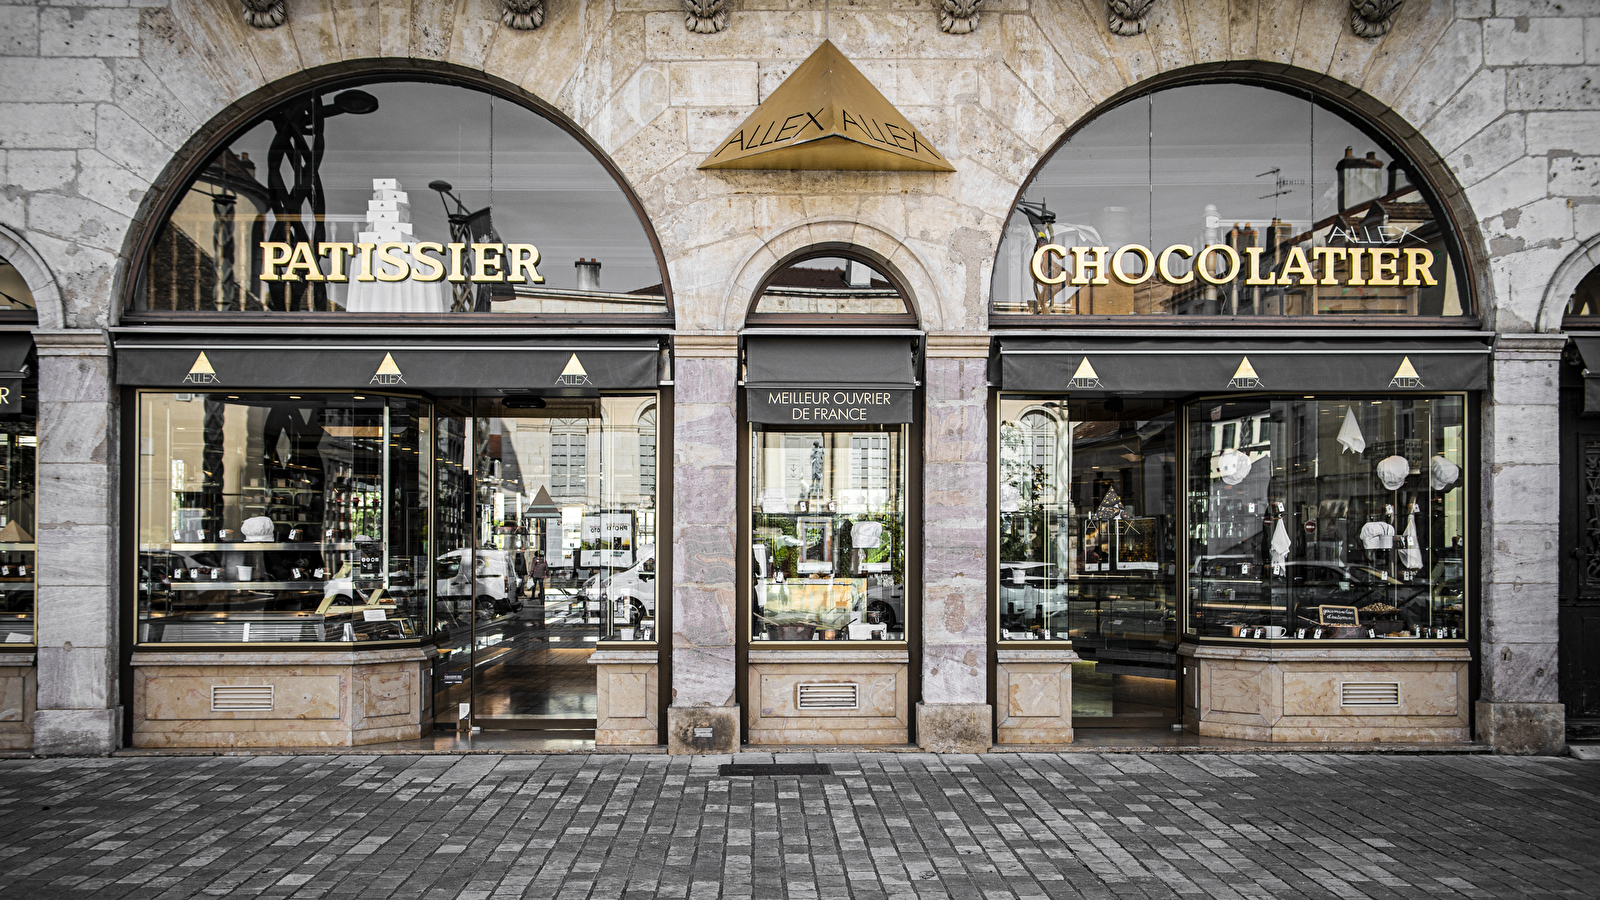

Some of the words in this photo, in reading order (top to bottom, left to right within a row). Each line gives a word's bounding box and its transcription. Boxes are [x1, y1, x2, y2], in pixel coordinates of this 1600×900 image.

[714, 107, 824, 158] ALLEX
[842, 109, 941, 160] ALLEX
[1327, 225, 1428, 244] ALLEX
[259, 241, 545, 284] PATISSIER
[1030, 243, 1438, 287] CHOCOLATIER
[182, 373, 221, 384] ALLEX
[369, 374, 407, 385] ALLEX
[554, 375, 593, 386] ALLEX
[1066, 378, 1105, 389] ALLEX
[1226, 378, 1265, 389] ALLEX
[1387, 378, 1426, 388] ALLEX
[768, 392, 830, 405] MEILLEUR
[833, 392, 891, 405] OUVRIER
[792, 408, 810, 420] DE
[814, 408, 867, 421] FRANCE
